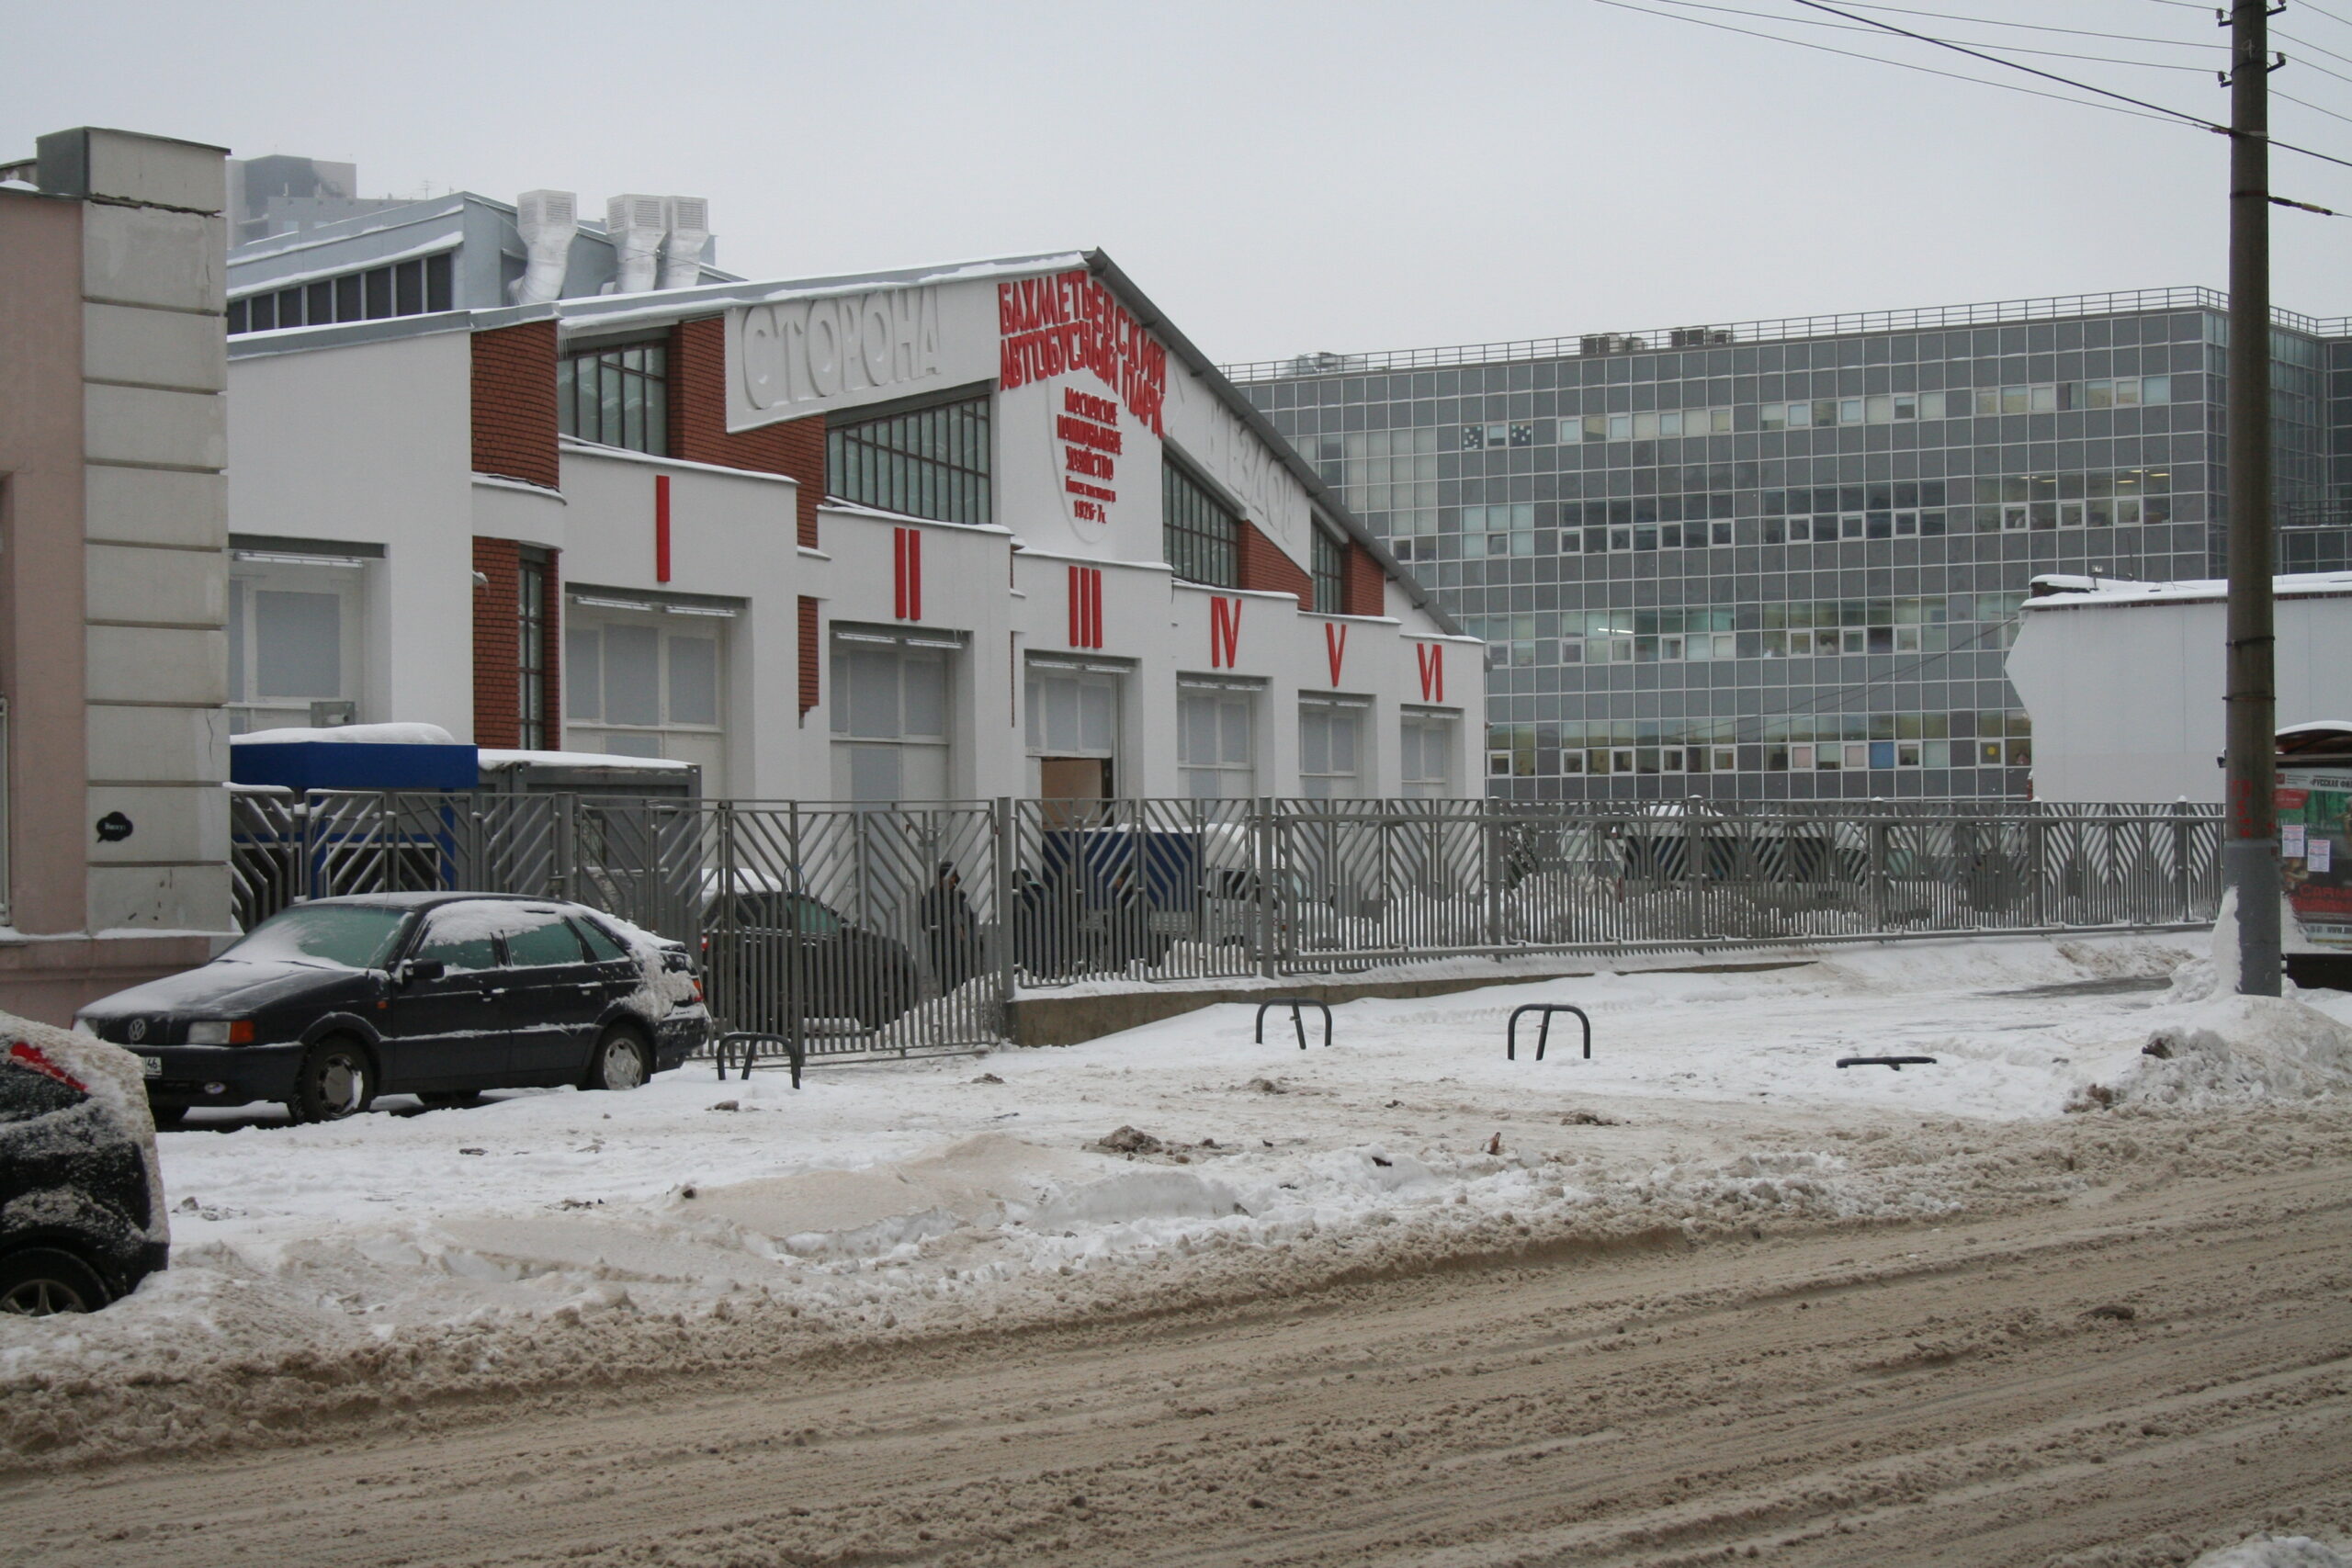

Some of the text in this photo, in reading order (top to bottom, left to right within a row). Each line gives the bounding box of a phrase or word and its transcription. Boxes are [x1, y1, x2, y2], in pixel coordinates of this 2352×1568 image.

[741, 286, 942, 411] СТОРОНА
[1000, 321, 1165, 440] АВТОБУСНЫЙ ПАРК
[1069, 566, 1102, 649] III
[1211, 596, 1242, 668] IV
[1326, 623, 1347, 687] V
[1417, 643, 1442, 702] VI
